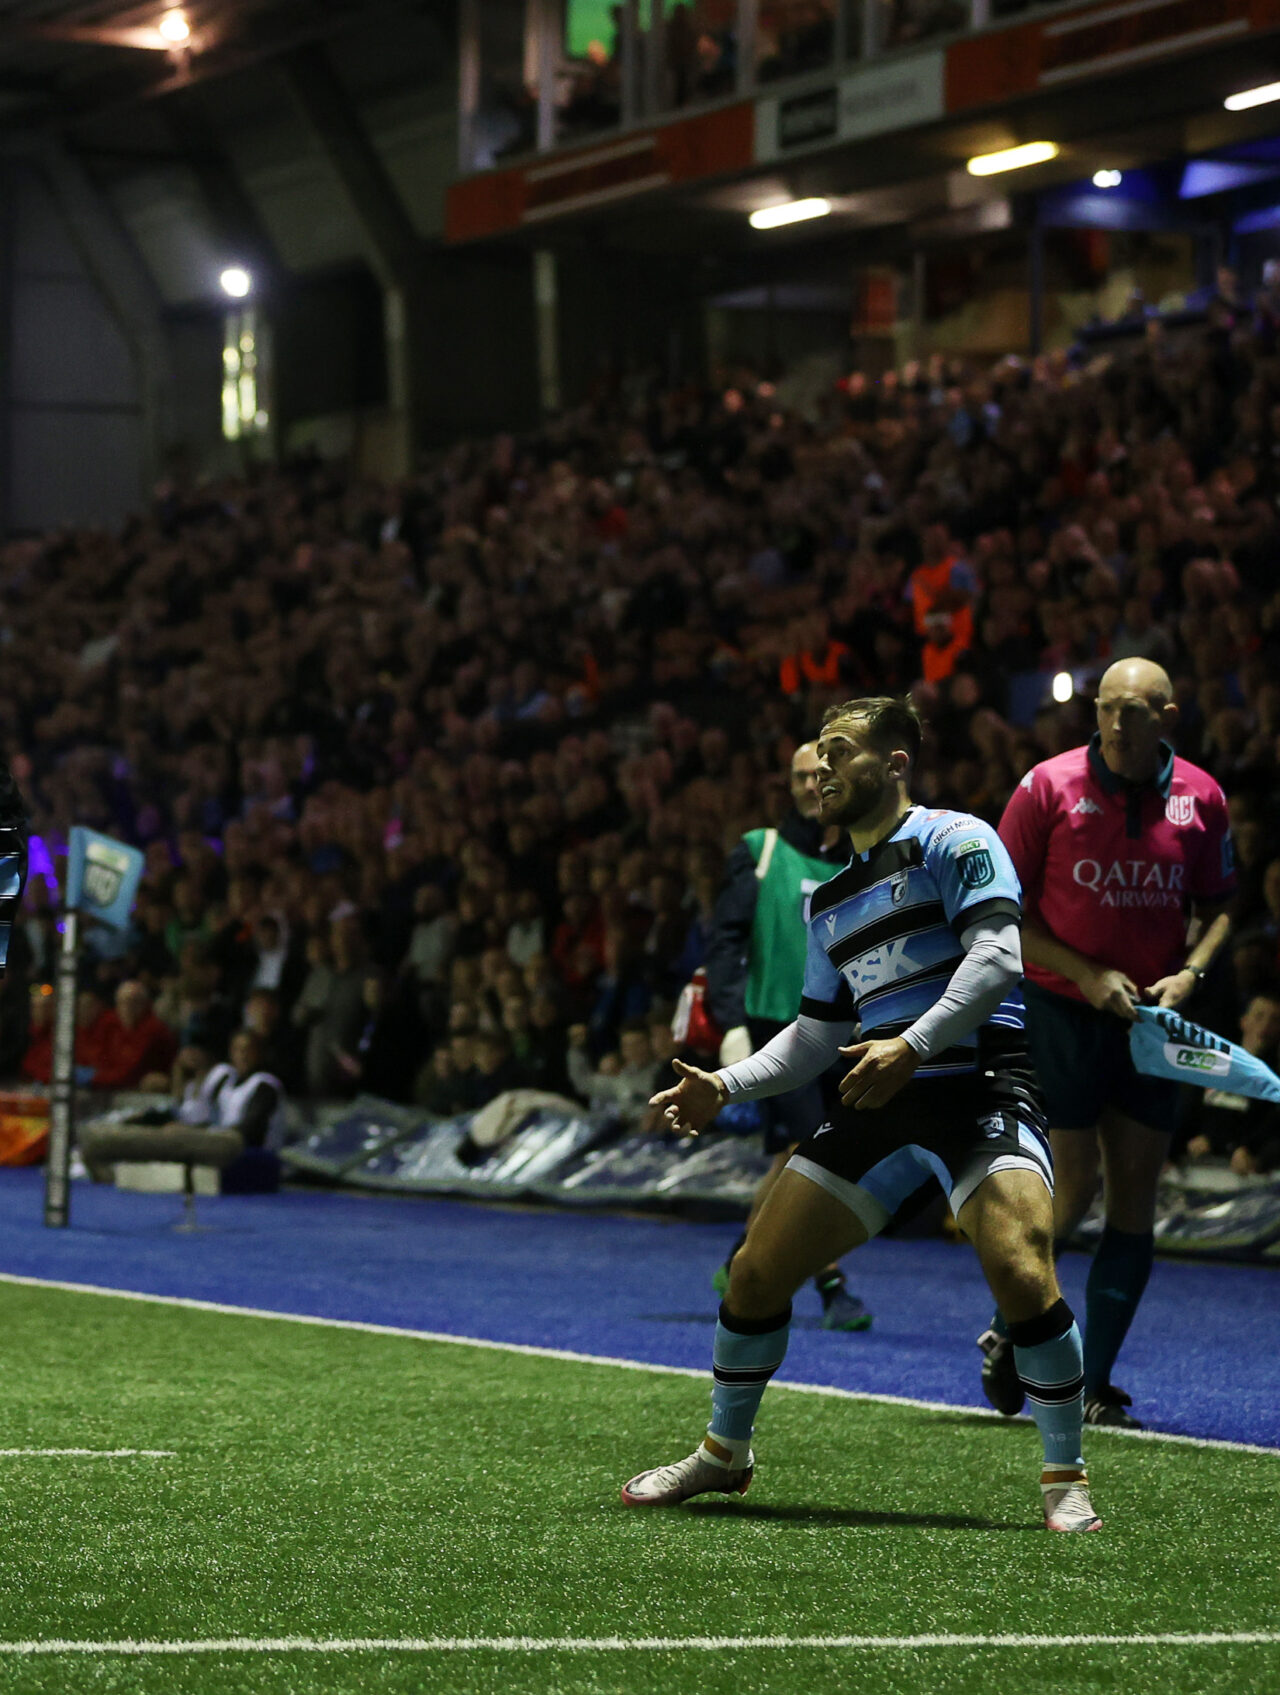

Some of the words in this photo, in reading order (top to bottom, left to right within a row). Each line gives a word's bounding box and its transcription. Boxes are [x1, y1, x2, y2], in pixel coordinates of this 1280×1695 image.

[933, 825, 955, 844] HIGH
[1072, 859, 1185, 892] QATAR
[1099, 890, 1182, 909] AIRWAYS
